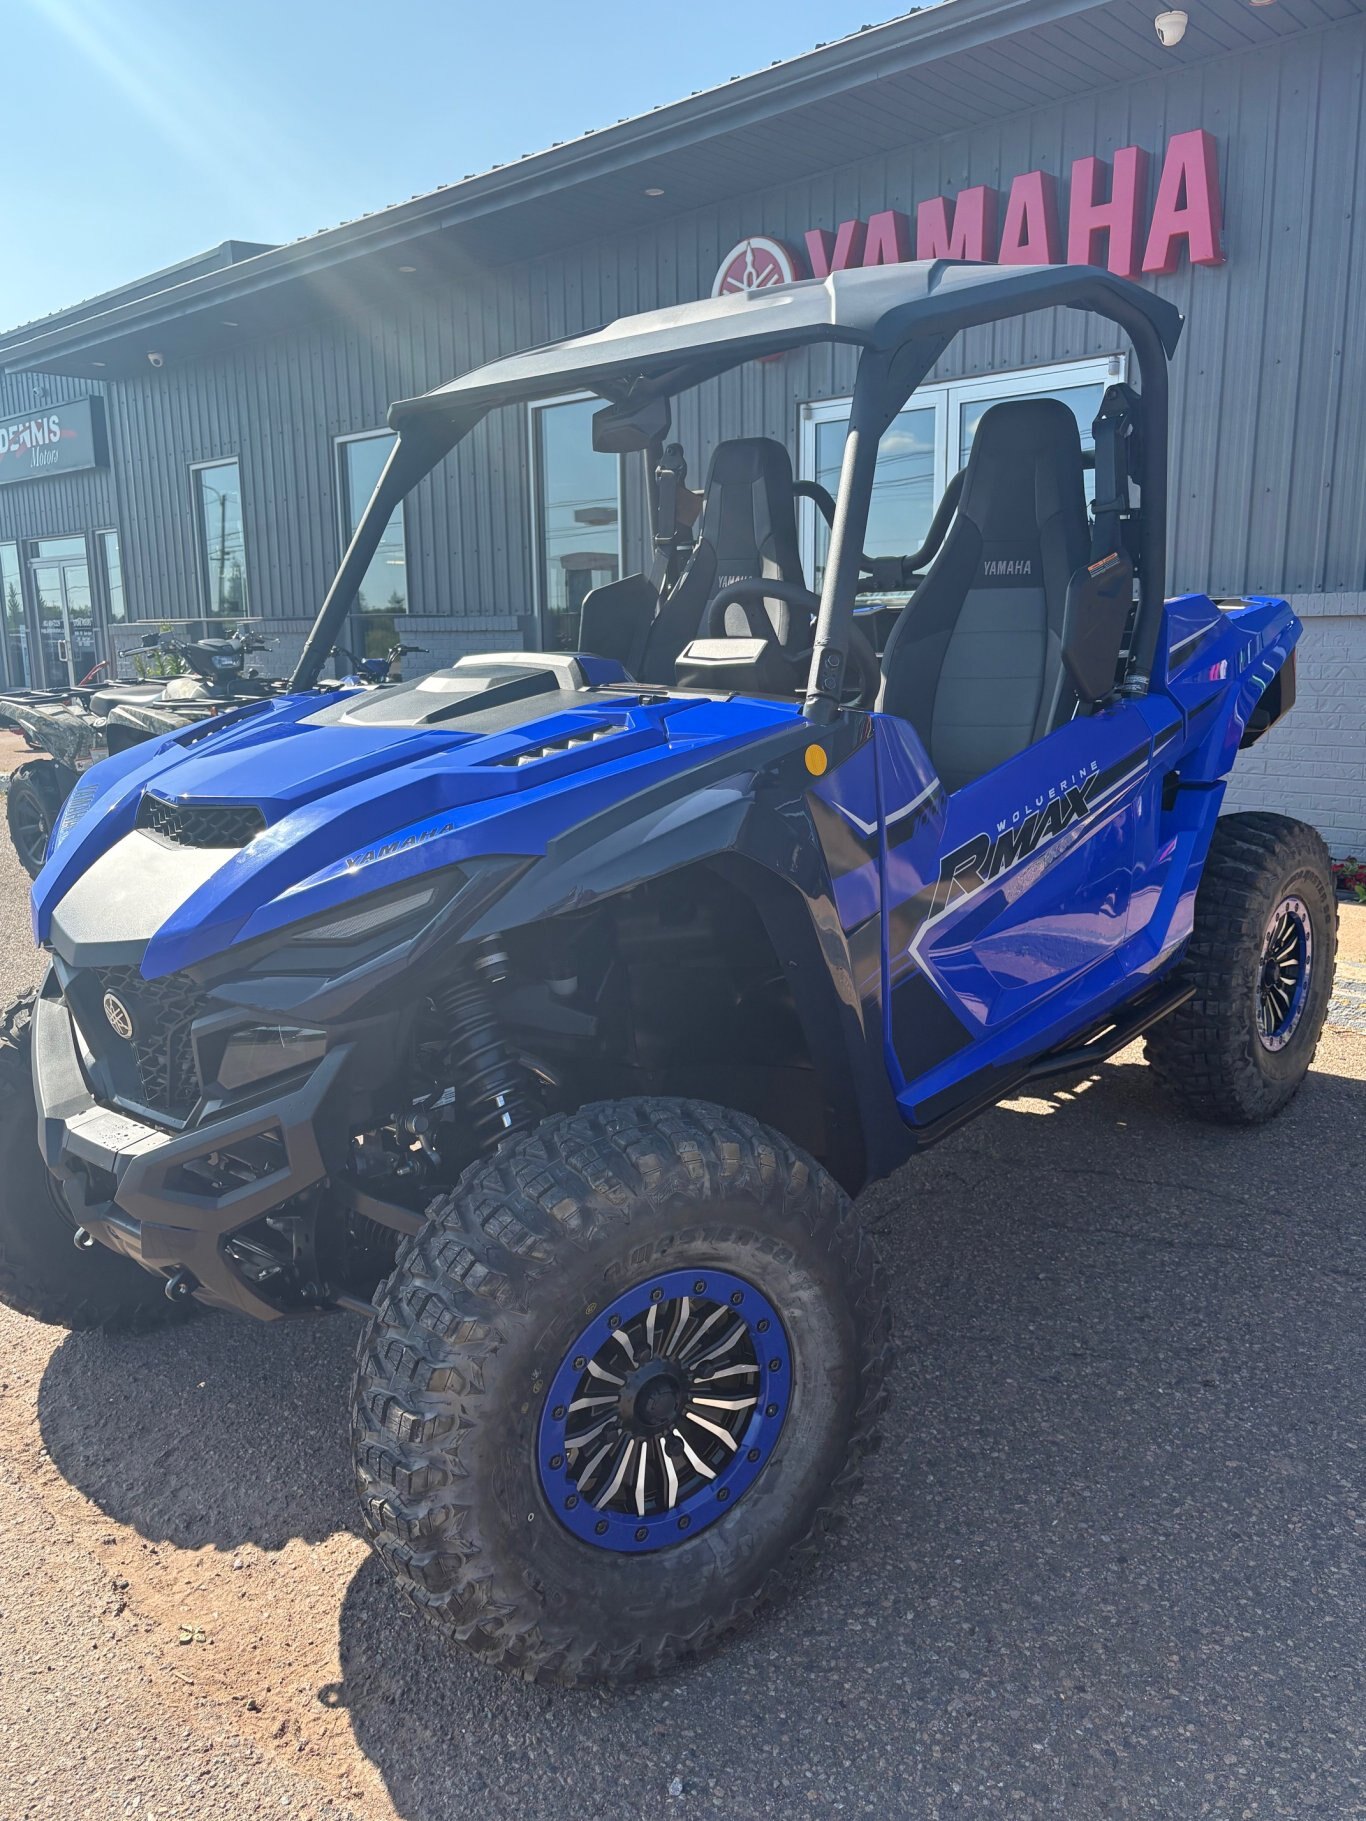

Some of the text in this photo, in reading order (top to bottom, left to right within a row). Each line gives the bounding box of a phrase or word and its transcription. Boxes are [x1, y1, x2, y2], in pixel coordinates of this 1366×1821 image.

[0, 415, 60, 454] DENNIS
[30, 446, 59, 468] Motors
[718, 575, 753, 588] YAMA
[984, 560, 1032, 576] YAMAHA
[345, 822, 455, 868] YAMAHA
[928, 769, 1100, 918] RMAX
